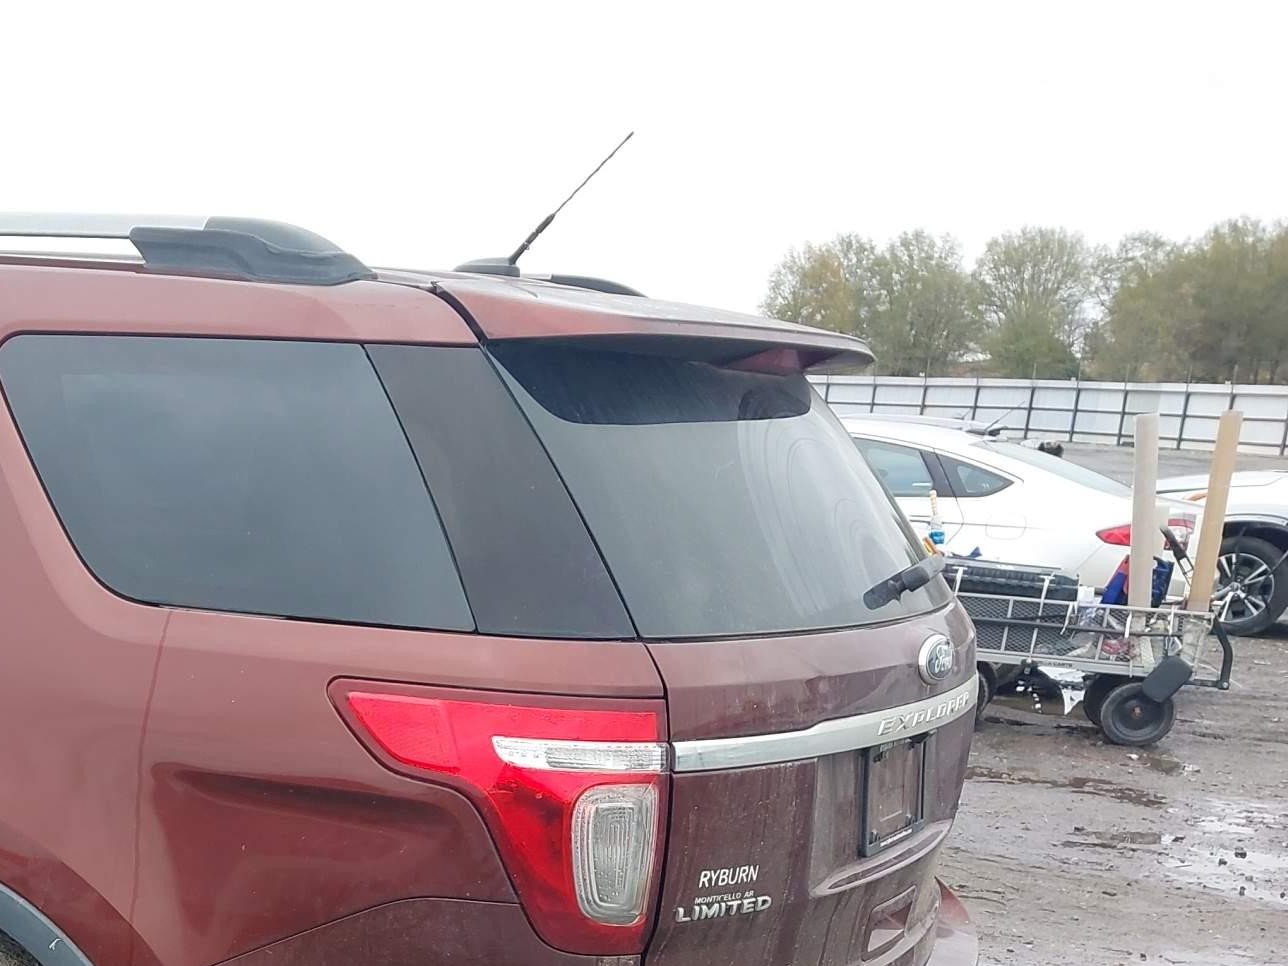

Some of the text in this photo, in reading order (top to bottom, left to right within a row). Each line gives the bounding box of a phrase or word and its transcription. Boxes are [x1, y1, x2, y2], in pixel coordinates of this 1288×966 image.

[698, 864, 760, 889] RYBURN
[675, 895, 772, 923] LIMITED
[694, 890, 755, 905] MONTICELLO AR
